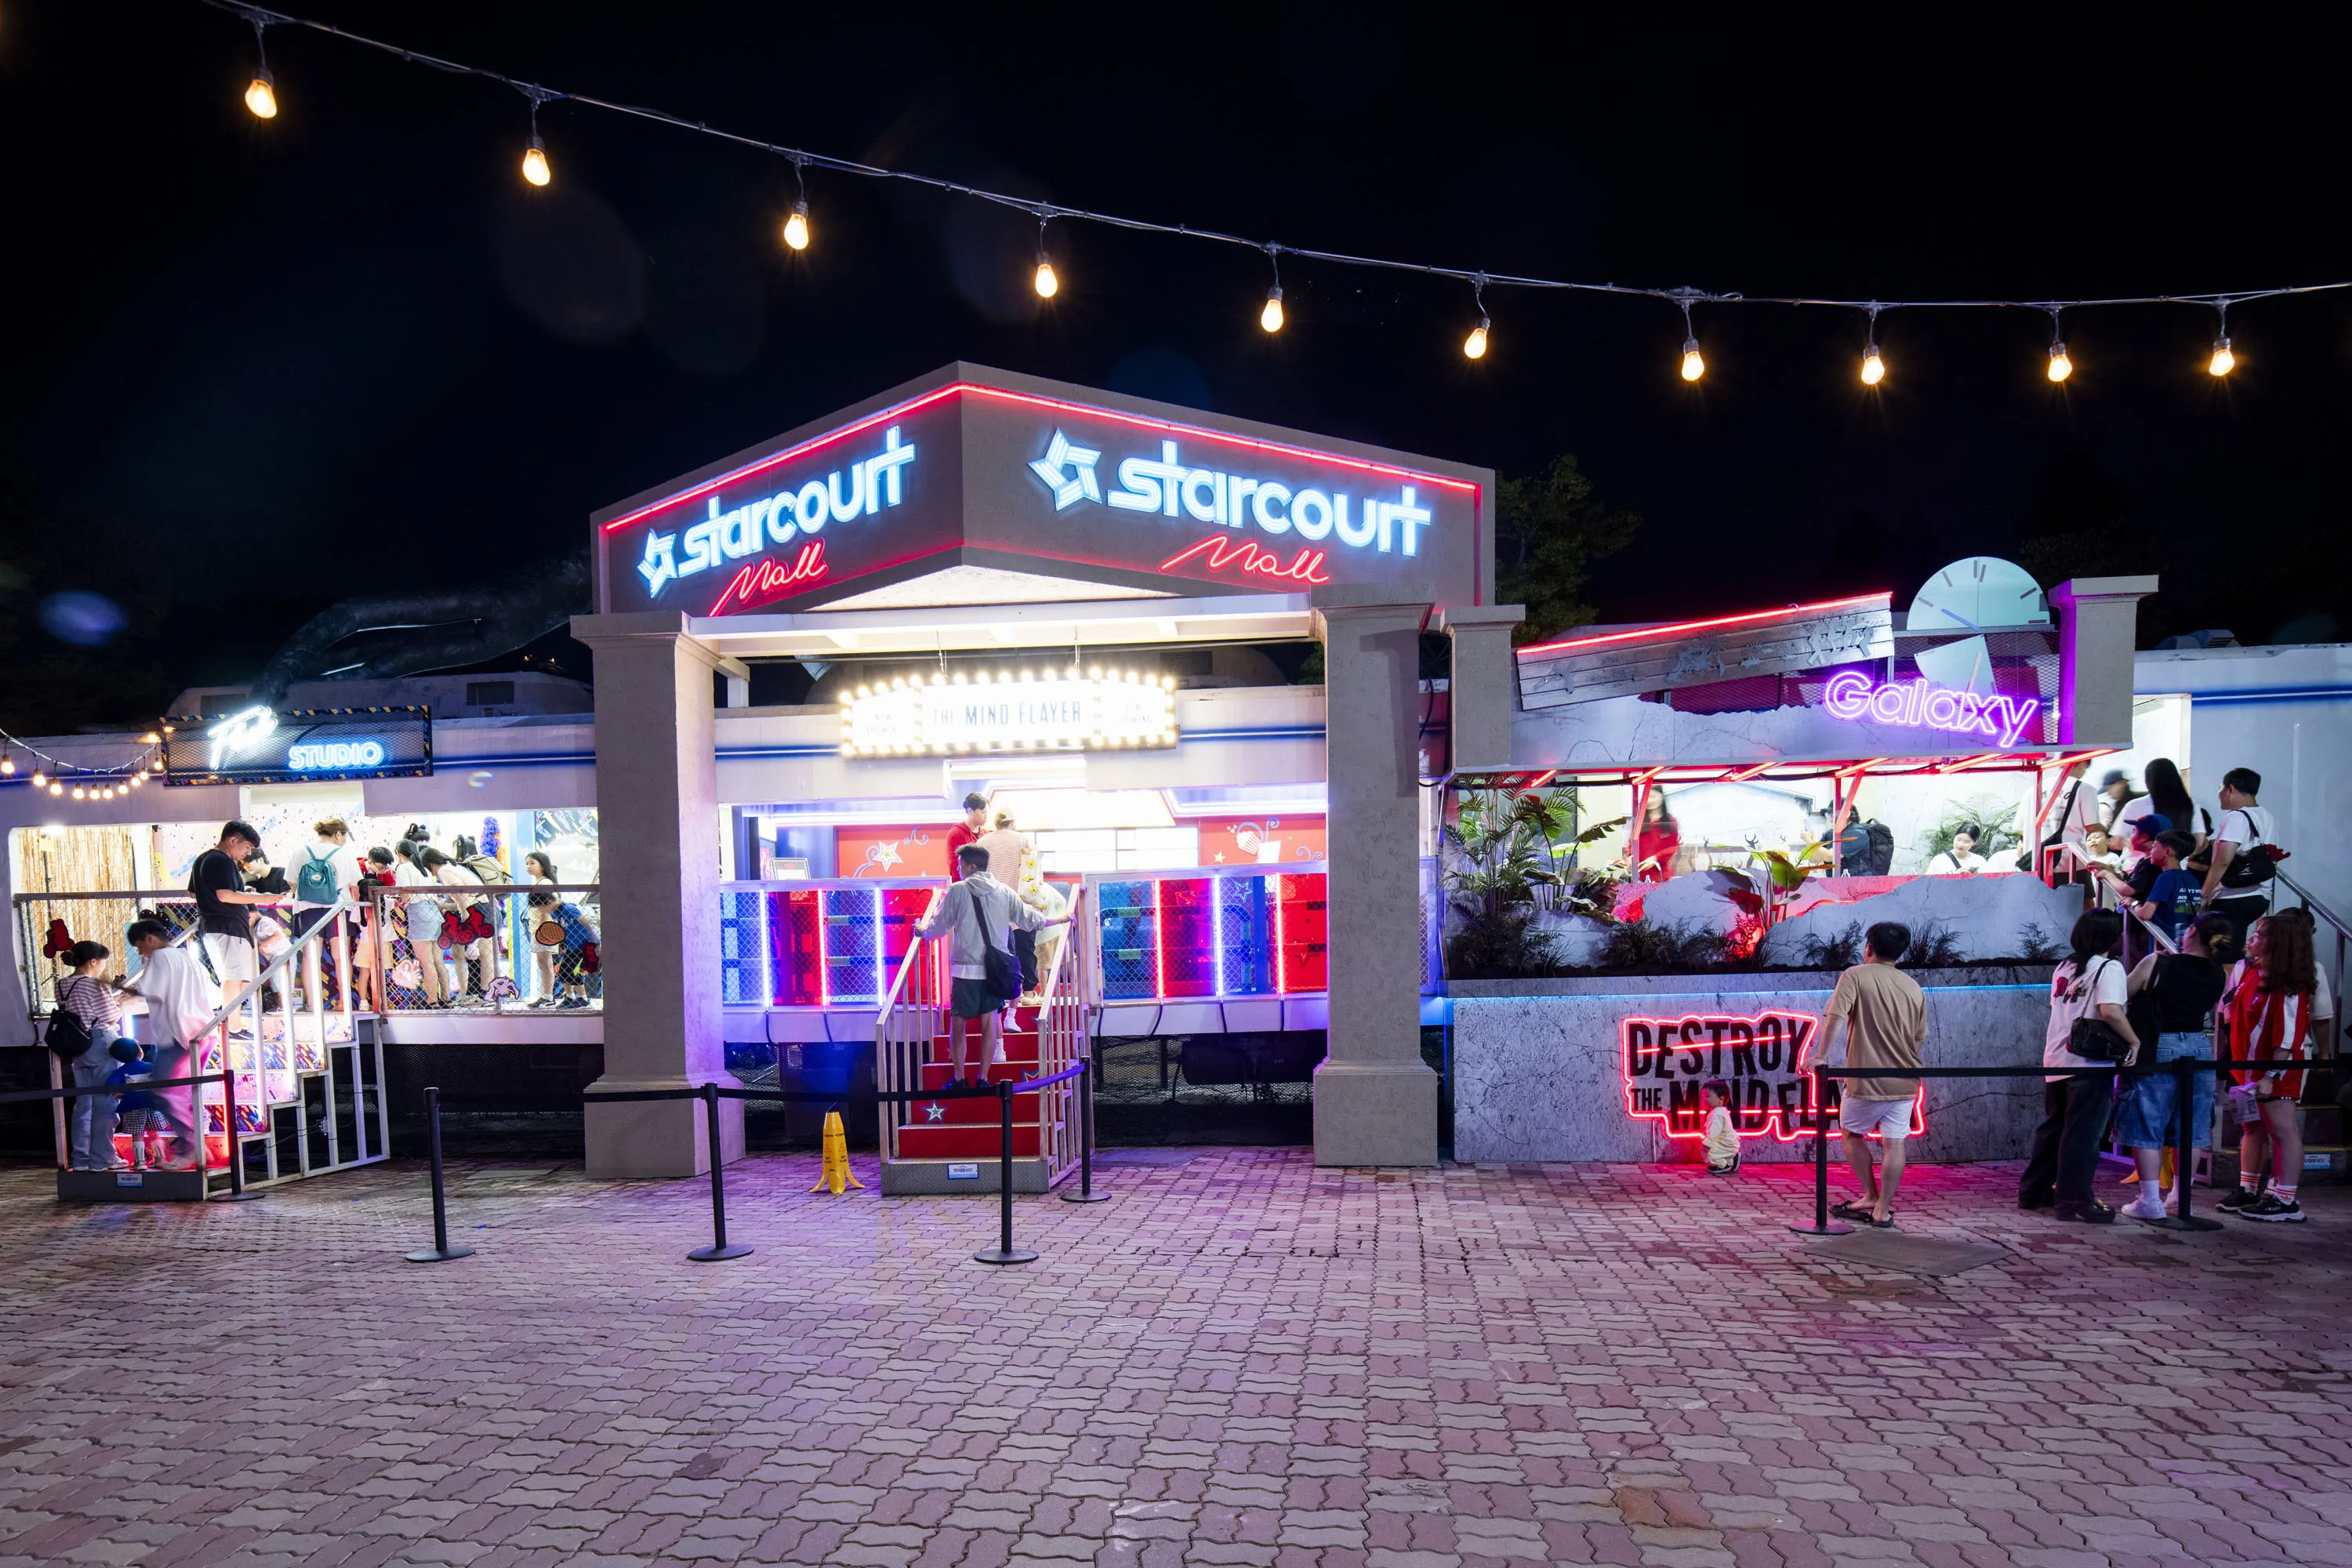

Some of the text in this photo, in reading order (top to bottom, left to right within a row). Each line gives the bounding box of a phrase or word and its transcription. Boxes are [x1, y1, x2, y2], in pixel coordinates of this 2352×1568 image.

[678, 425, 916, 578] starcourt
[1108, 440, 1431, 556] starcourt
[710, 538, 829, 616] Mall
[1158, 535, 1330, 583] Mall
[965, 704, 1010, 727] MIND
[1018, 700, 1083, 726] FLAYER
[1823, 670, 2038, 749] Galaxy
[288, 739, 384, 770] STUDIO
[1628, 1017, 1813, 1079] DESTROY
[1631, 1087, 1663, 1112] THE
[1670, 1078, 1770, 1133] MND
